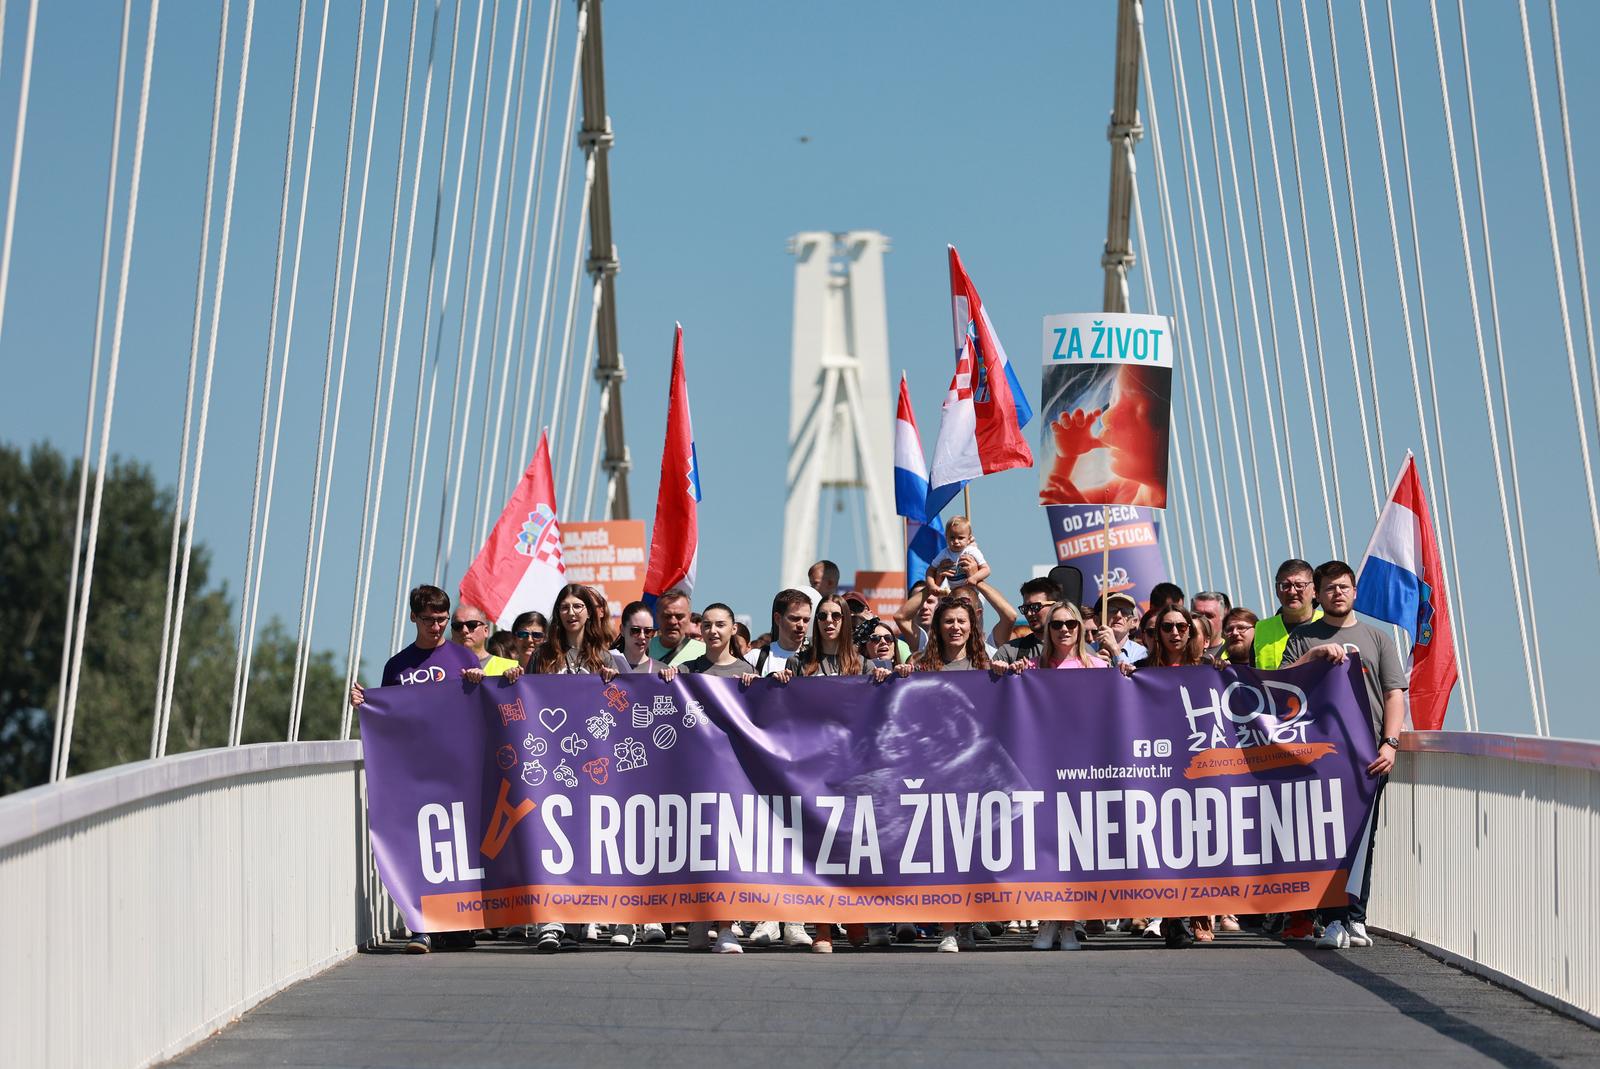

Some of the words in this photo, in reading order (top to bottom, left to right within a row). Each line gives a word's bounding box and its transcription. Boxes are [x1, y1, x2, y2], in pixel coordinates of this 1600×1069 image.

[1052, 327, 1083, 360] ZA
[1090, 320, 1163, 361] ŽIVOT
[1063, 514, 1083, 533] OD
[1060, 534, 1104, 558] DIJETE
[1108, 525, 1153, 546] ŠTUCA
[400, 665, 446, 685] HOD
[1180, 680, 1308, 733] HOD
[1187, 723, 1229, 752] ZA
[1235, 718, 1316, 749] ŽIVOT
[1056, 764, 1173, 780] www.hodzazivot.hr
[1196, 761, 1208, 769] ZA
[1209, 757, 1236, 768] ŽIVOT,
[590, 792, 804, 876] ROĐENIH
[815, 795, 884, 875] ZA
[900, 778, 1045, 874] ŽIVOT
[1056, 778, 1348, 872] NEROĐENIH
[457, 896, 510, 912] IMOTSKI
[515, 894, 540, 907] KNIN
[553, 894, 608, 906] OPUZEN
[620, 894, 668, 906] OSIJEK
[679, 892, 726, 904] RIJEKA
[738, 891, 770, 904] SINJ
[783, 893, 825, 906] SISAK
[838, 894, 919, 906] SLAVONSKI
[922, 893, 962, 905] BROD
[974, 891, 1012, 904] SPLIT
[1024, 888, 1098, 902] VARAŽDIN
[1109, 888, 1178, 900] VINKOVCI
[1191, 886, 1240, 899] ZADAR
[1252, 881, 1310, 896] ZAGREB
